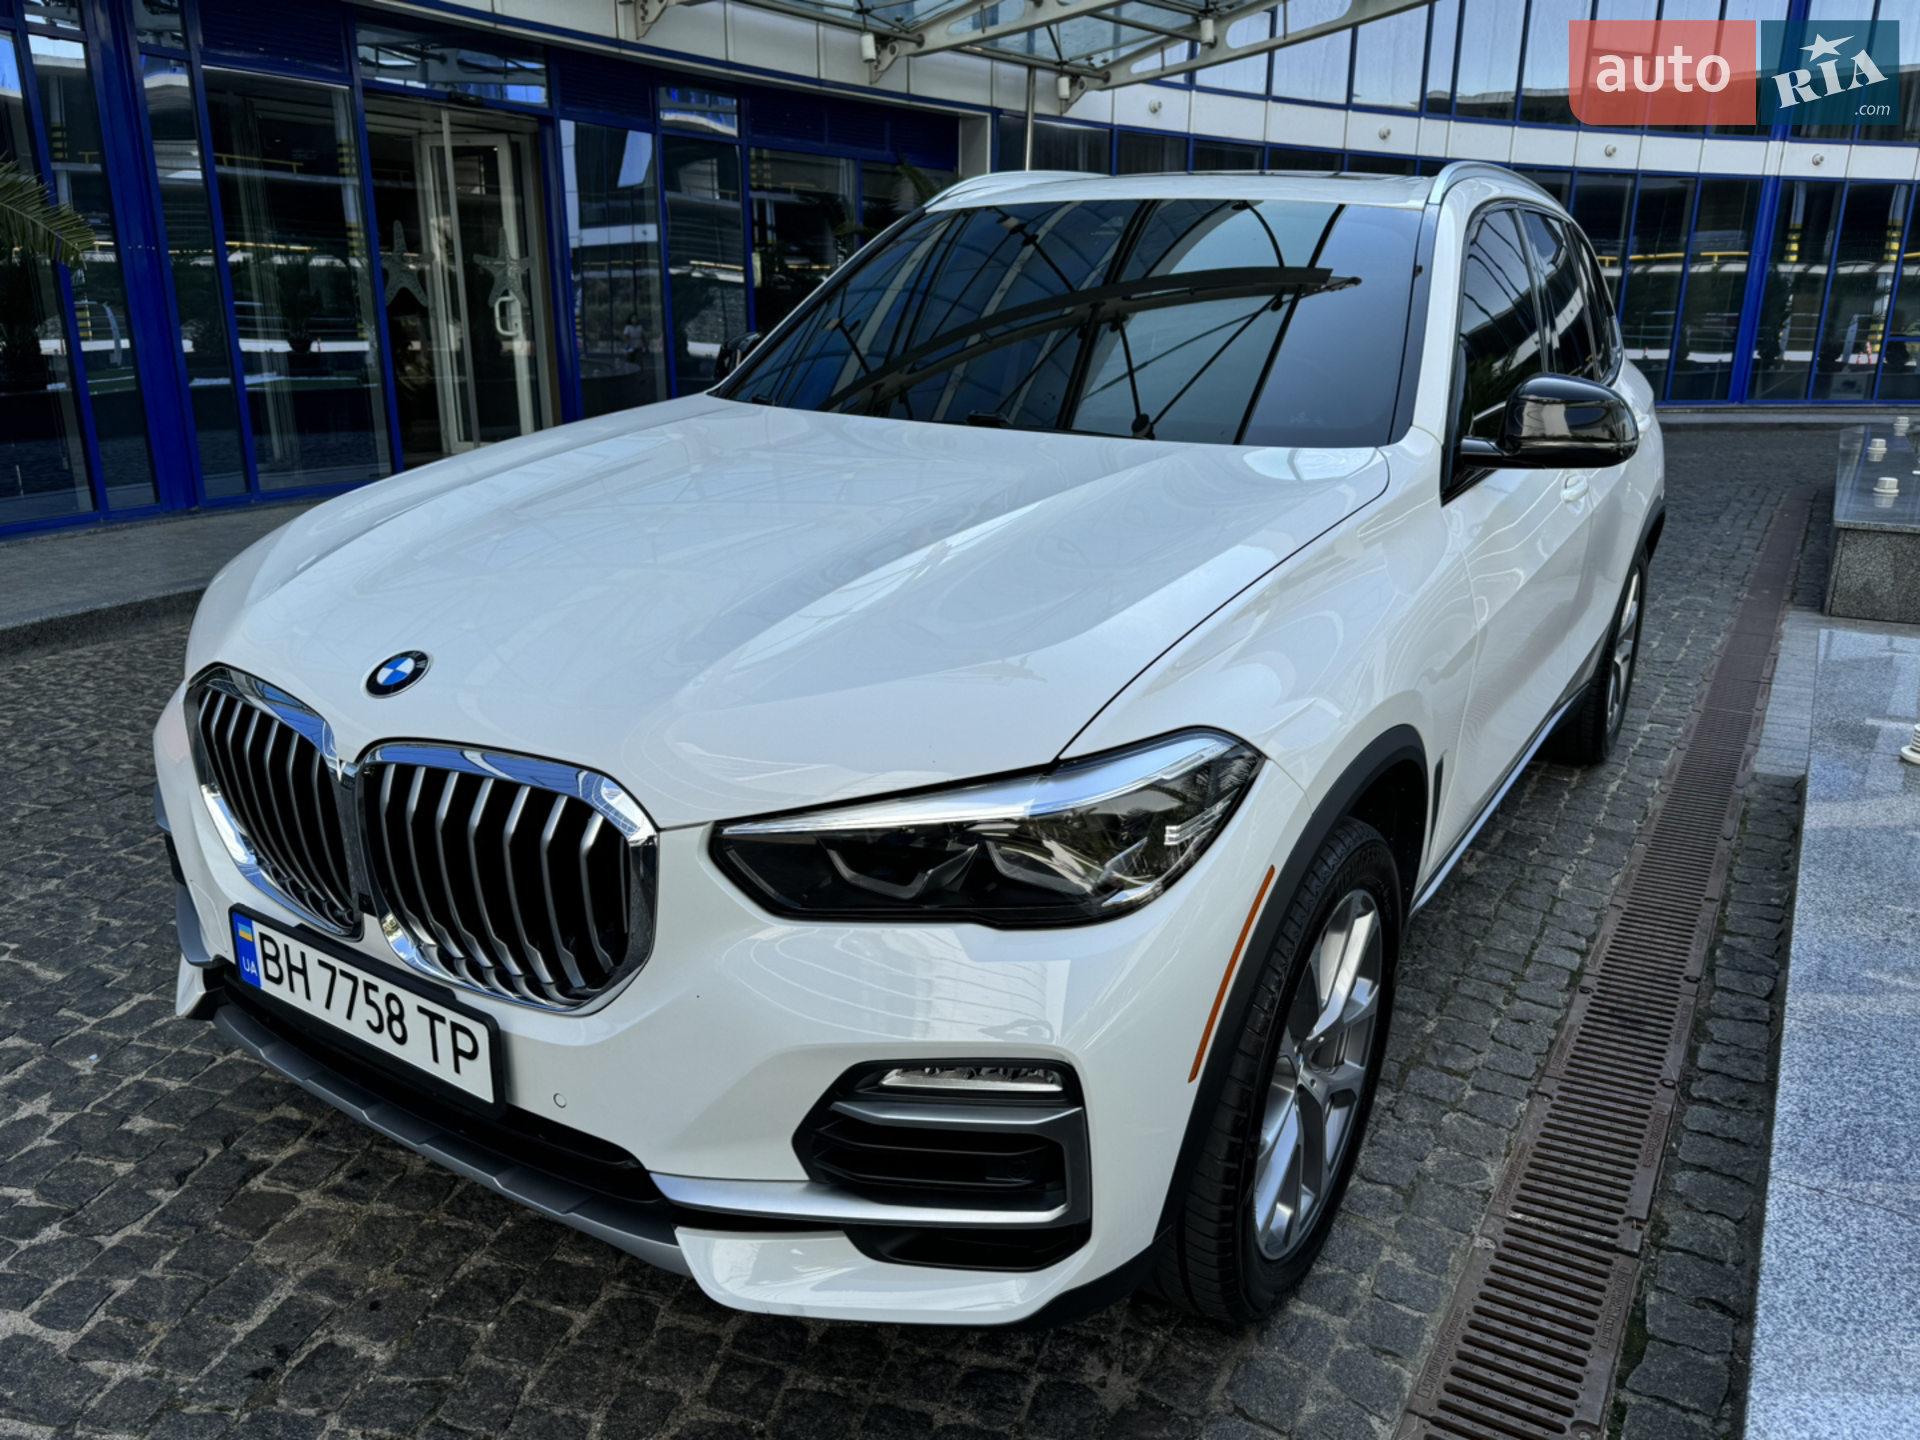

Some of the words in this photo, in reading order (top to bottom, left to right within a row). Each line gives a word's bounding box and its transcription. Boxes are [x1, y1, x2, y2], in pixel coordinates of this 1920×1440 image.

[241, 955, 258, 977] UA
[258, 931, 311, 1001] BH
[317, 959, 408, 1046] 7758
[416, 1004, 479, 1075] TP
